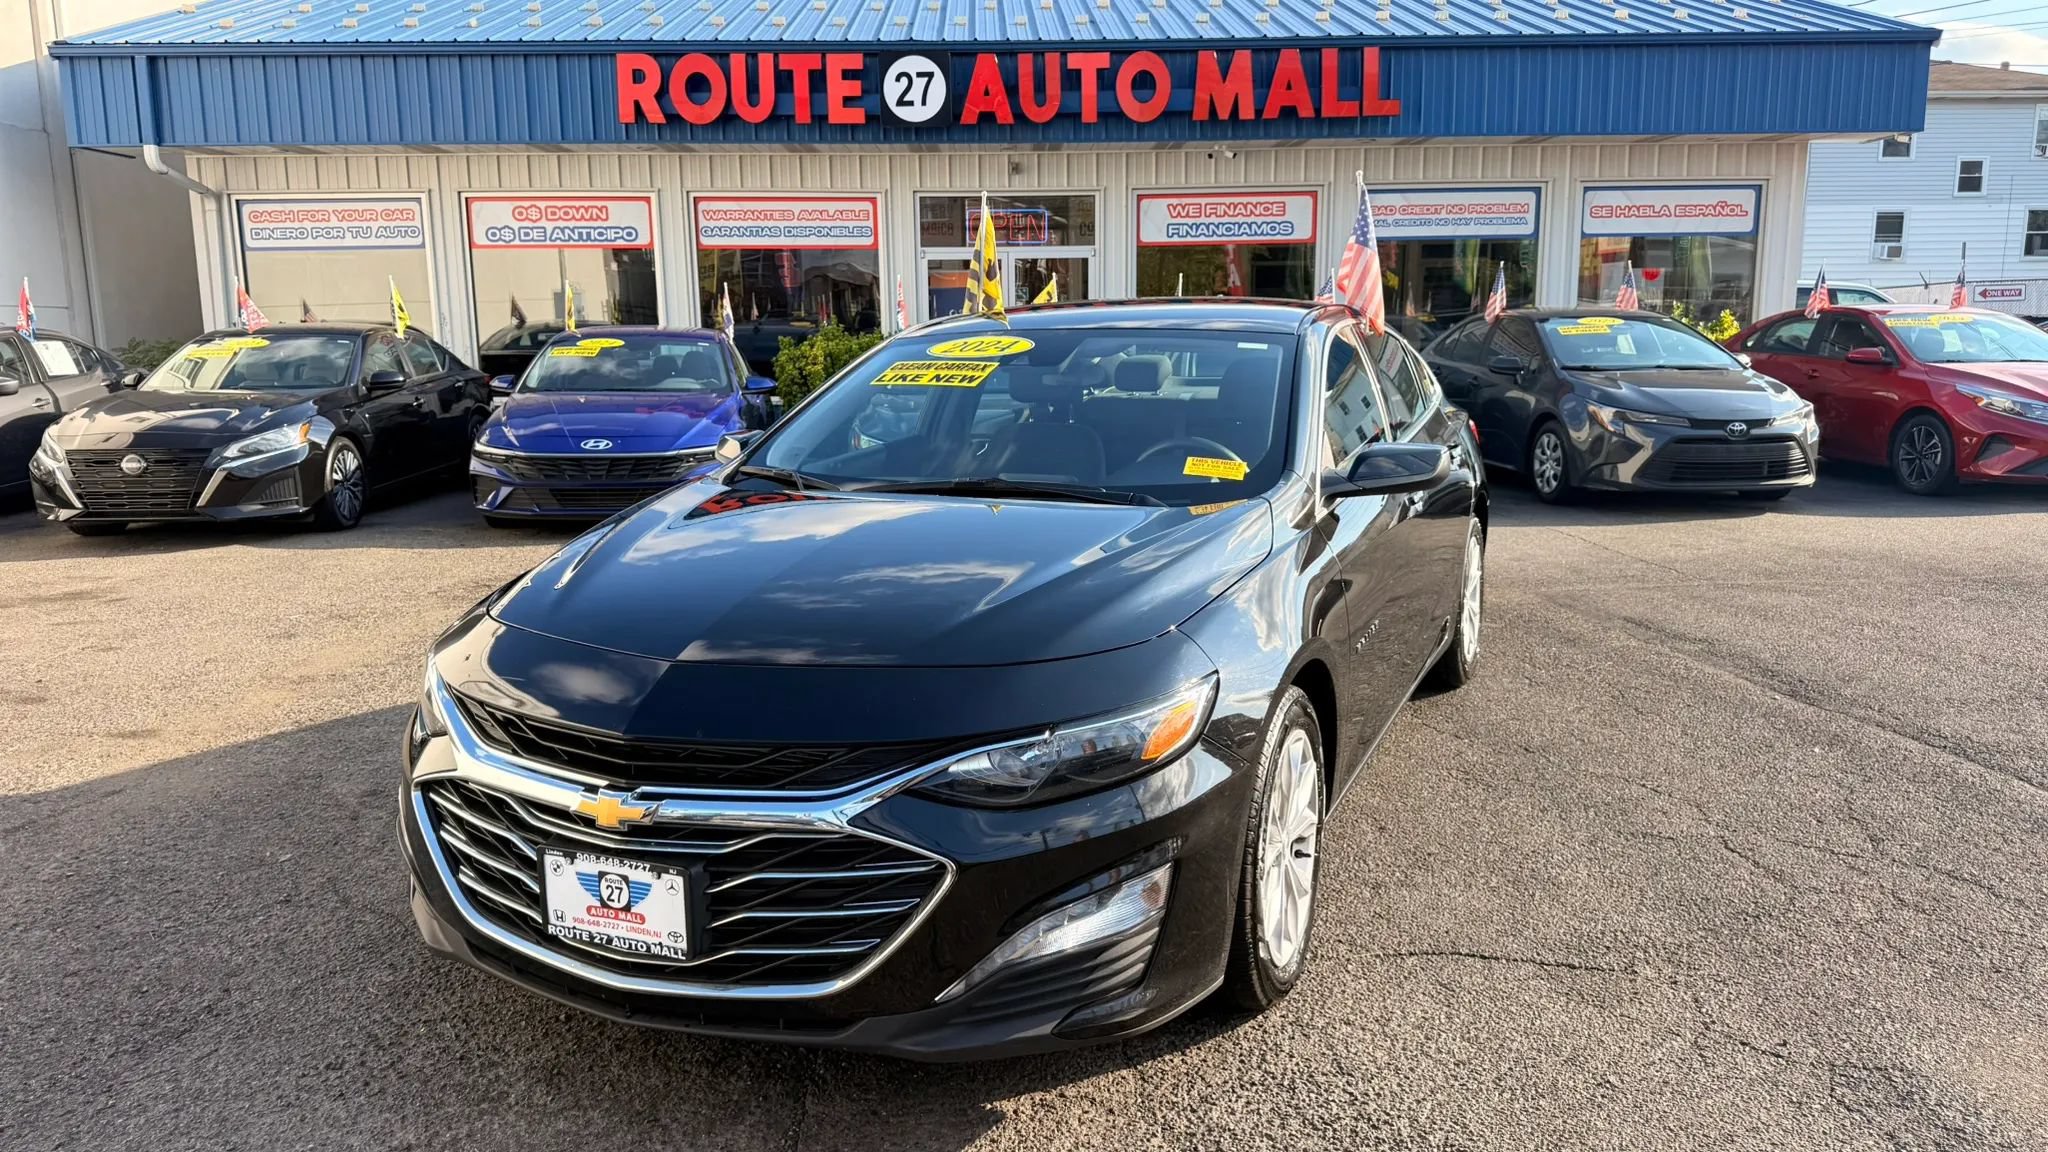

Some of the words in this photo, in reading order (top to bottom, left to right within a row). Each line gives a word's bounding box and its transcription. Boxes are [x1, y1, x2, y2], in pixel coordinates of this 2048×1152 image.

[616, 53, 866, 124] ROUTE
[894, 71, 934, 107] 27
[960, 50, 1171, 125] AUTO
[1192, 46, 1400, 121] MALL
[249, 210, 295, 223] CASH
[297, 210, 330, 222] FOR
[333, 209, 378, 222] YOUR
[380, 208, 416, 221] CAR
[545, 205, 608, 222] DOWN
[702, 209, 794, 222] WARRANTIES
[797, 209, 870, 221] AVAILABLE
[1167, 203, 1201, 218] WE
[1204, 201, 1286, 218] FINANCE
[1371, 204, 1396, 216] BAD
[1398, 204, 1445, 215] CREDIT
[1446, 203, 1467, 215] NO
[1468, 203, 1529, 214] PROBLEM
[1590, 206, 1613, 218] SE
[1615, 205, 1671, 218] HABLA
[1673, 200, 1748, 218] ESPAÑOL
[970, 212, 1045, 242] OPEN
[1167, 221, 1294, 238] FINANCIAMOS
[1392, 218, 1433, 227] CREDITO
[1435, 218, 1450, 226] NO
[1451, 217, 1473, 226] HAY
[1474, 217, 1528, 226] PROBLEMA
[250, 227, 308, 240] DINERO
[311, 227, 344, 239] POR
[348, 226, 372, 239] TU
[375, 226, 421, 238] AUTO
[518, 227, 546, 242] DE
[550, 226, 638, 242] ANTICIPO
[700, 226, 781, 238] GARANTIAS
[784, 226, 872, 238] DISPONIBLES
[941, 340, 1020, 353] 2024
[890, 362, 935, 371] CLEAN
[934, 363, 994, 373] CARFAX
[876, 373, 924, 382] LIKE
[928, 374, 982, 384] NEW
[576, 853, 650, 873] 908-648-2727
[605, 877, 623, 885] ROUTE
[605, 885, 623, 904] 27
[590, 907, 615, 919] AUTO
[618, 911, 642, 922] MALL
[572, 917, 619, 929] 908-648-2727
[548, 925, 590, 940] ROUTE
[594, 932, 607, 944] 27
[612, 937, 646, 952] AUTO
[651, 944, 686, 960] MALL
